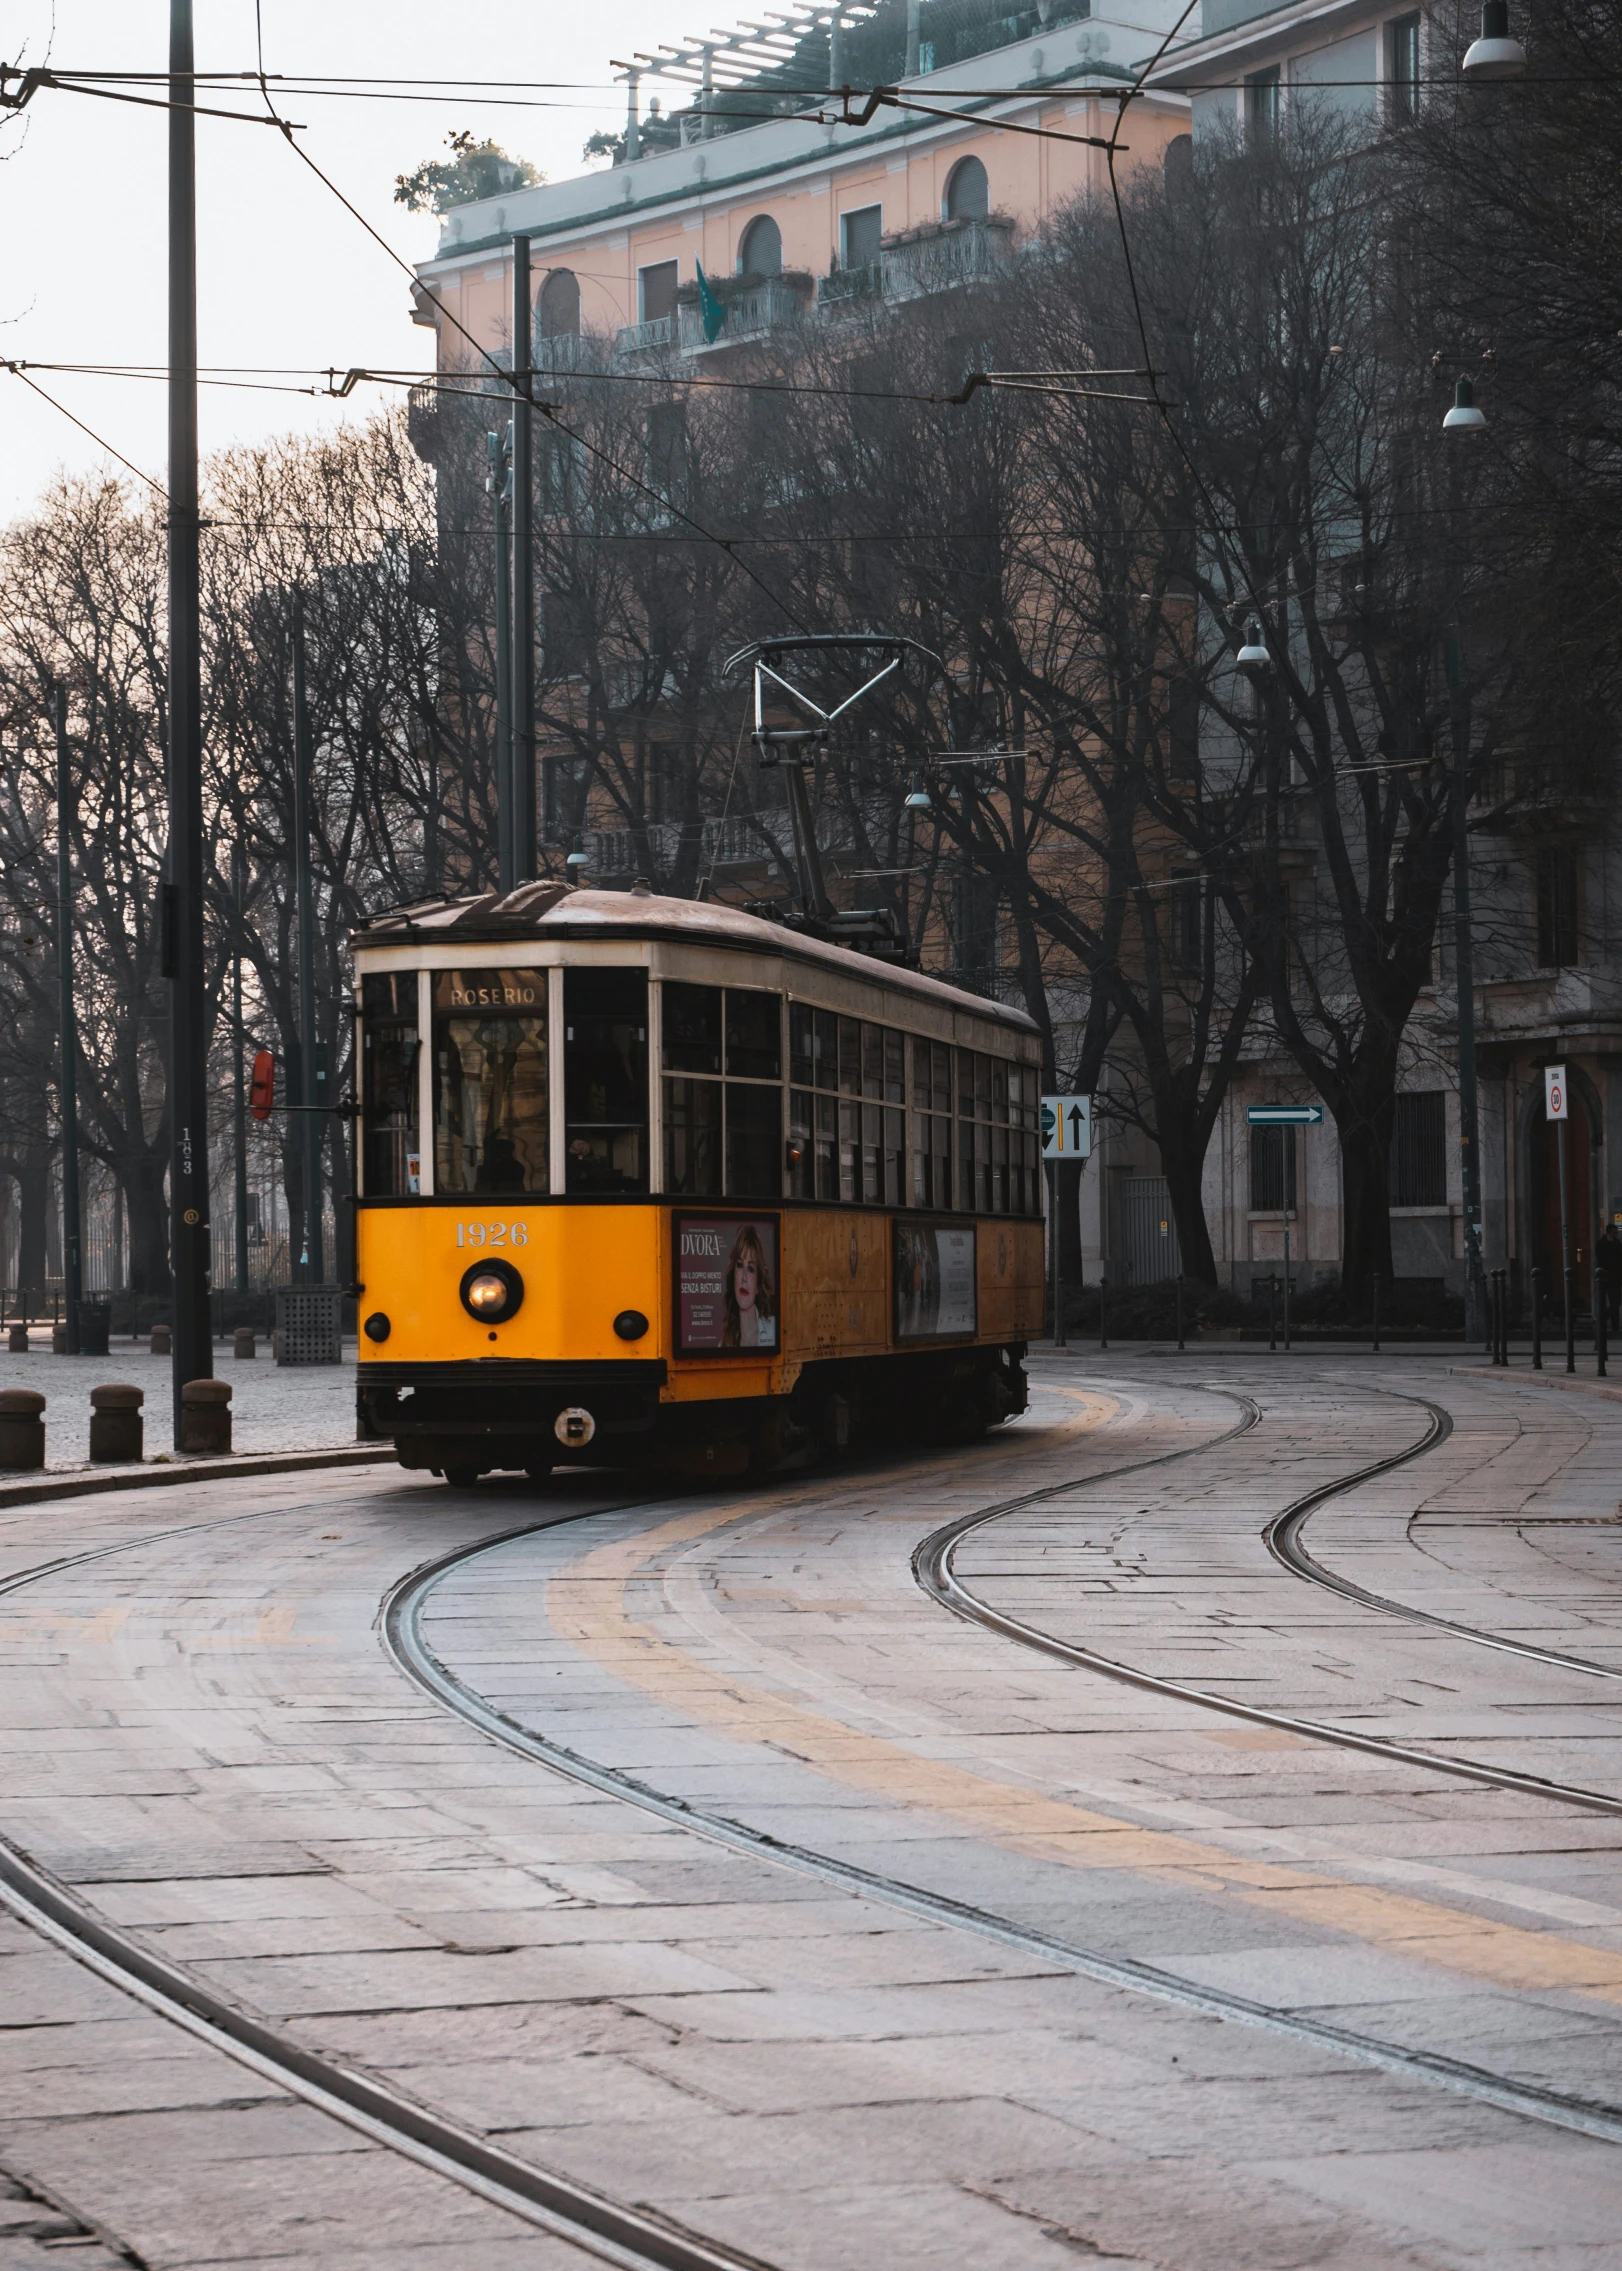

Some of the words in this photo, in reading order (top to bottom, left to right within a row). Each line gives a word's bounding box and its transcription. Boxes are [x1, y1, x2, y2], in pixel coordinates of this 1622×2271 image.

[451, 988, 535, 1006] ROSERIO
[1553, 1094, 1559, 1104] 30
[456, 1221, 529, 1248] 1926
[680, 1234, 720, 1256] DVORA
[681, 1283, 699, 1293] SENZA
[700, 1283, 722, 1293] BISTURI
